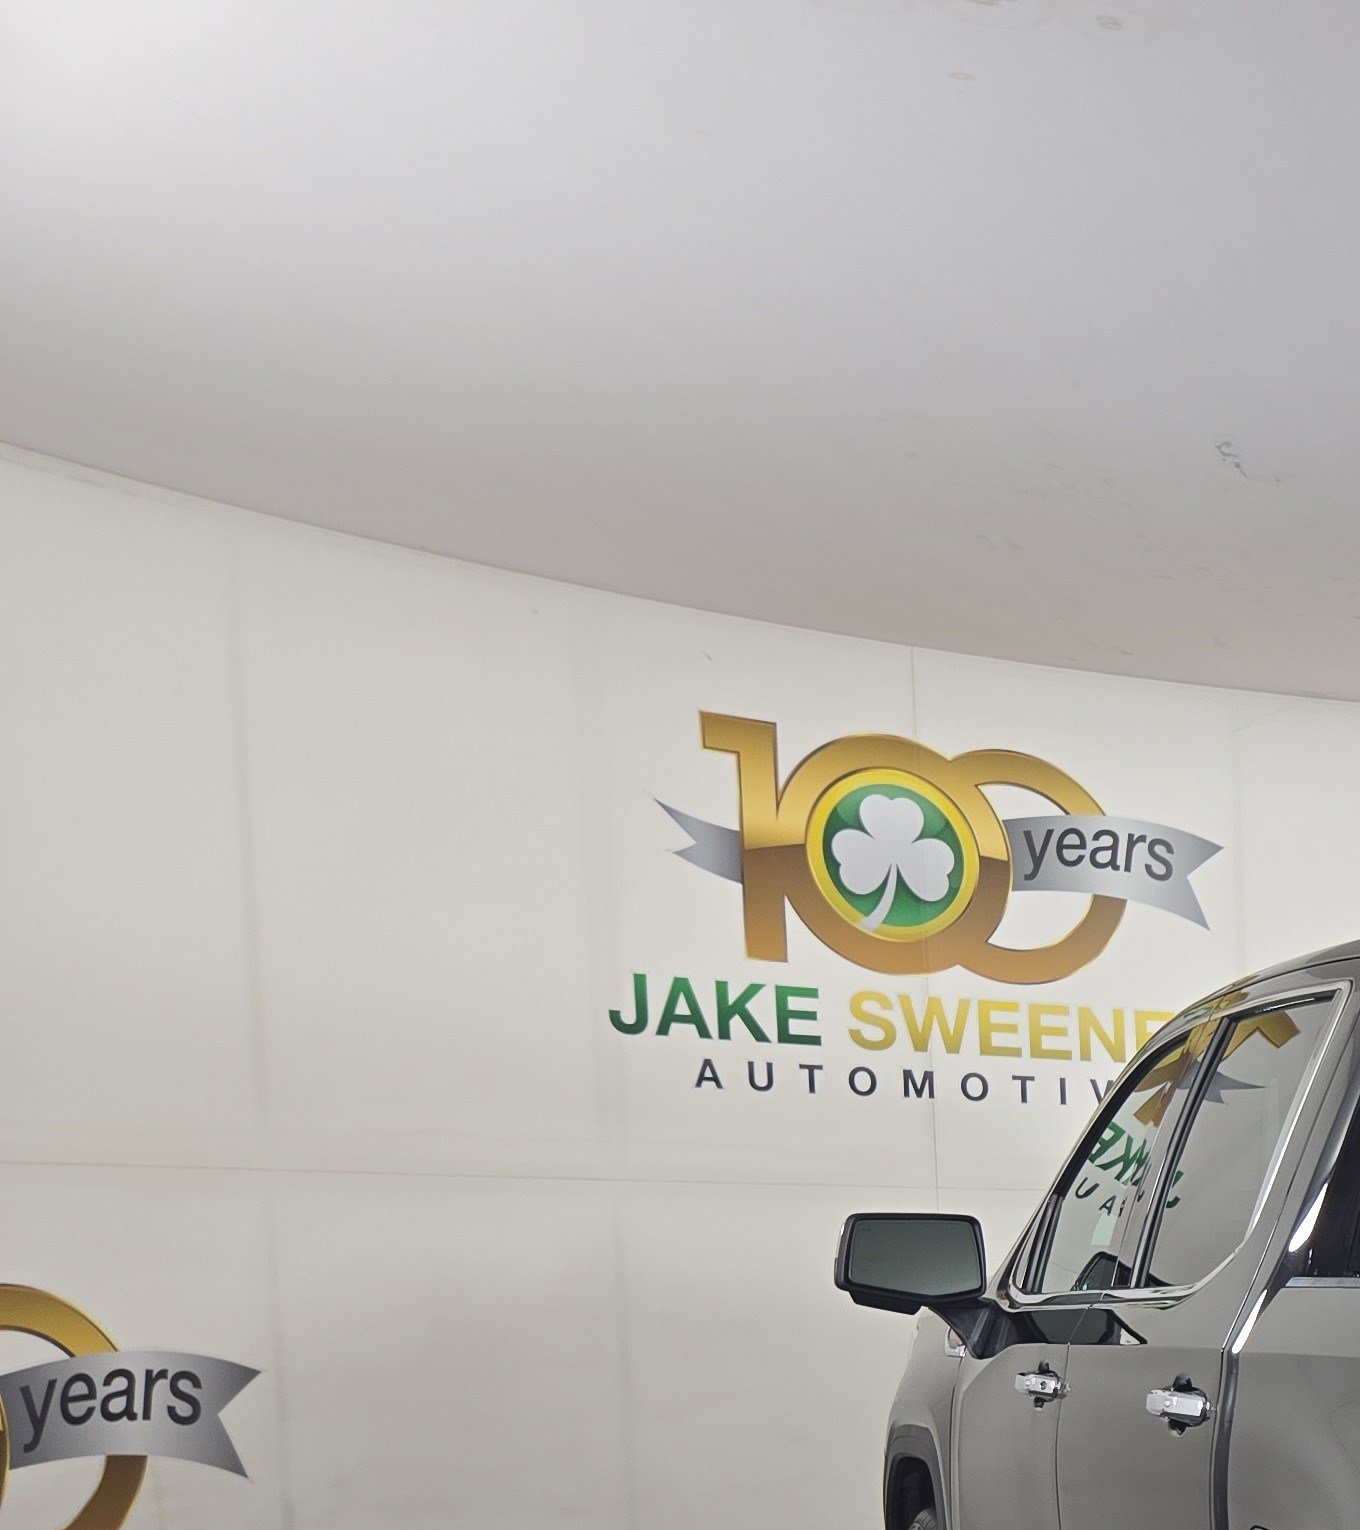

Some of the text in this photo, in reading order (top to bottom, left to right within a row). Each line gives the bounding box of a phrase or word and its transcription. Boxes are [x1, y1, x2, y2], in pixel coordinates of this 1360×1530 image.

[1022, 827, 1174, 881] years
[608, 973, 1174, 1064] JAKE SWEEN
[695, 1058, 1115, 1106] AUTOMOTIV
[20, 1367, 203, 1454] years
